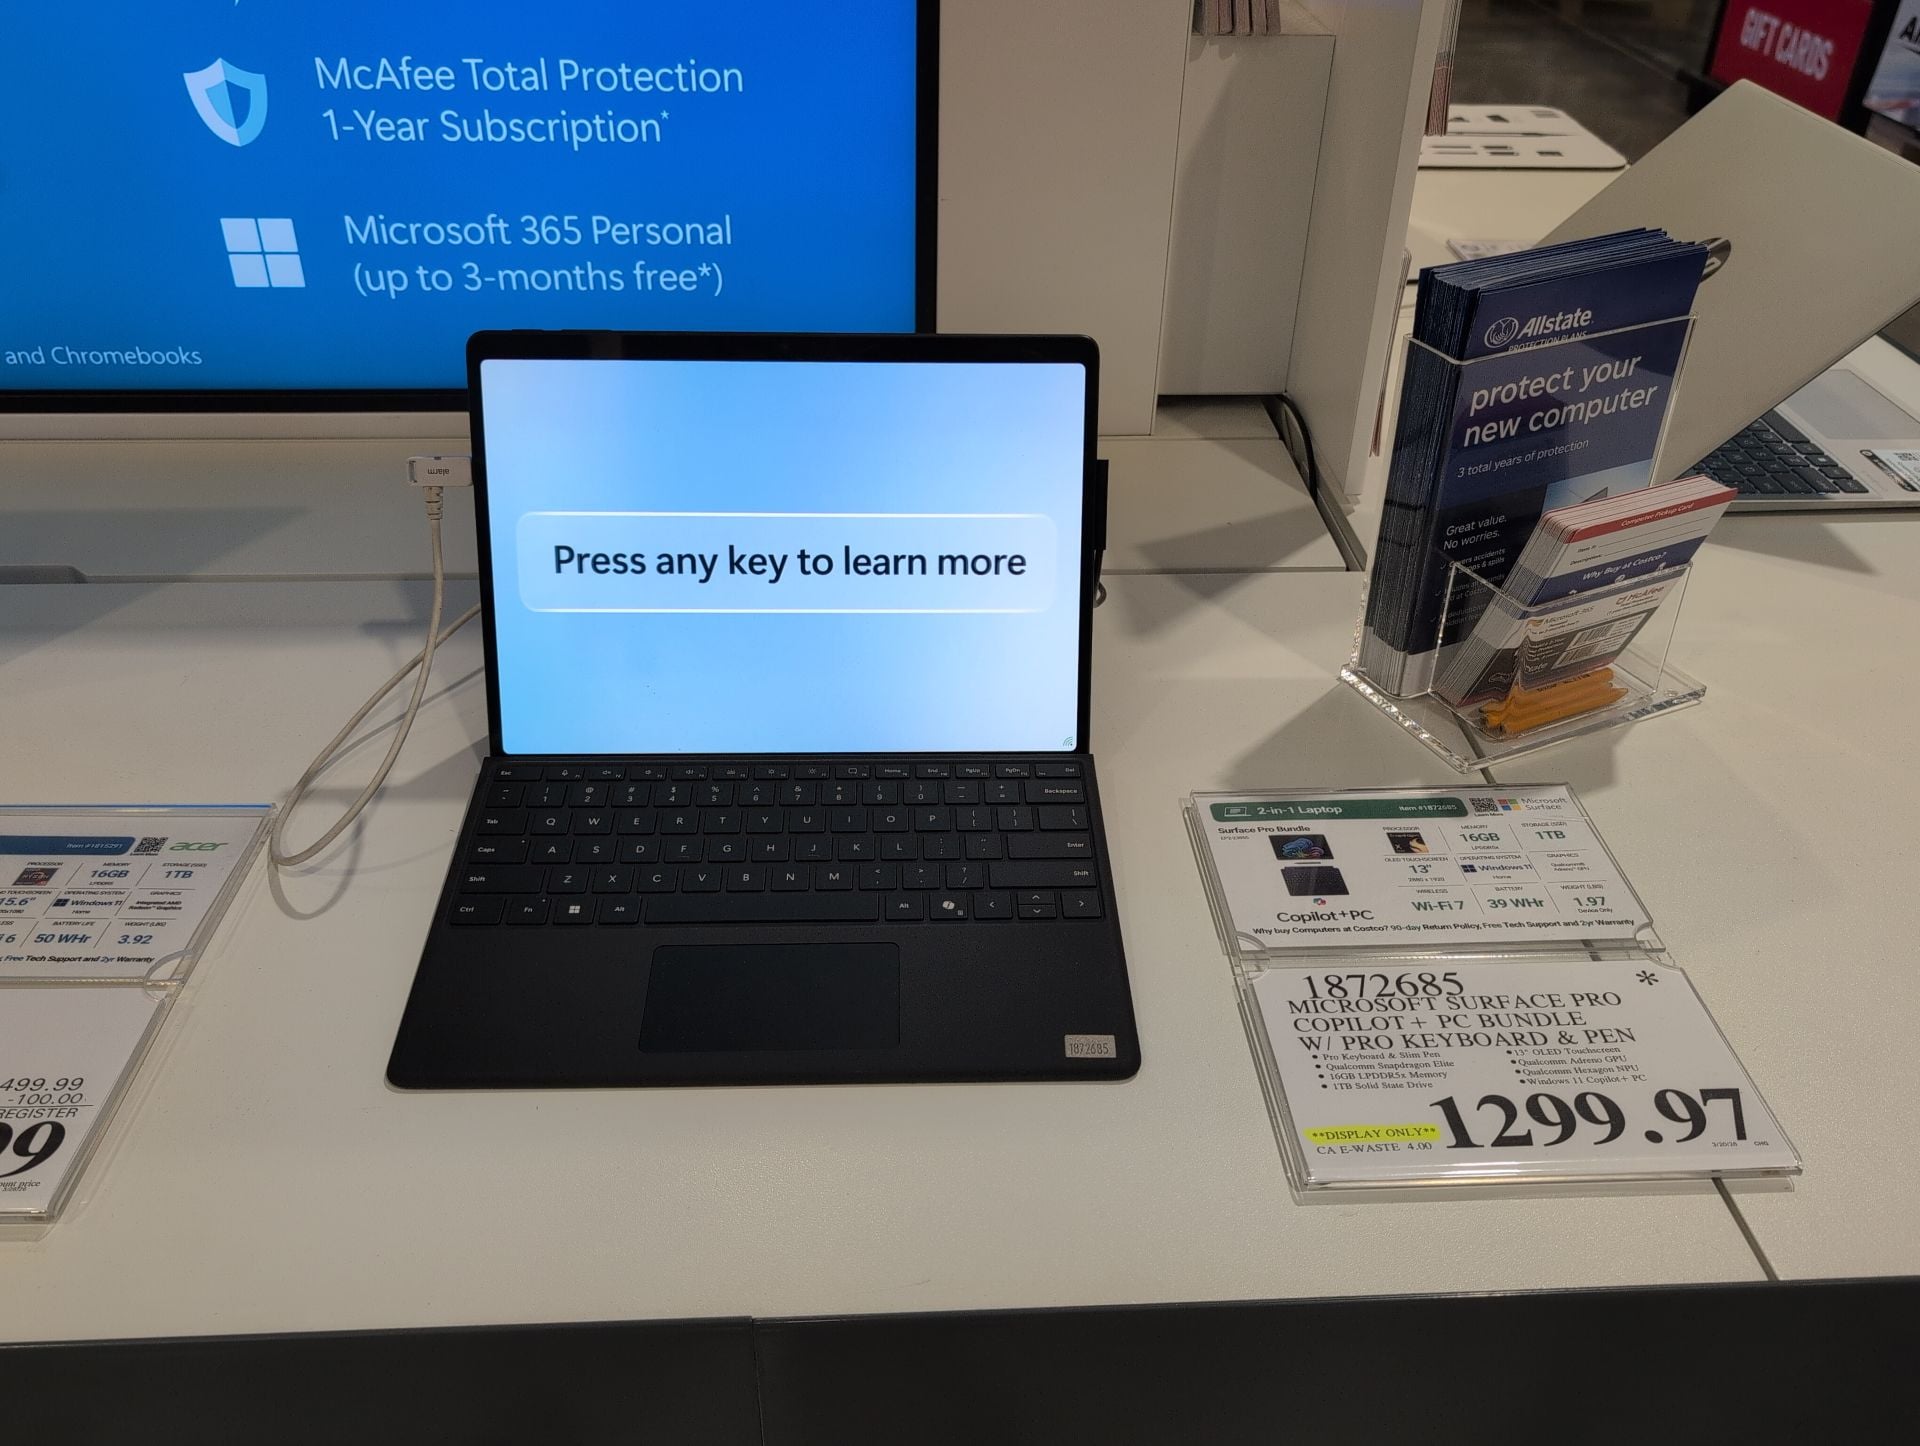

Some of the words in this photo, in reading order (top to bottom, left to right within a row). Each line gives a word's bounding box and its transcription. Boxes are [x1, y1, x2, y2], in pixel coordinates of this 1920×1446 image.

[1740, 7, 1781, 56] GIFT
[1775, 22, 1834, 81] CARDS
[314, 57, 455, 92] McAfee
[463, 59, 548, 92] Total
[559, 60, 744, 93] Protection
[323, 110, 429, 142] 1-Year
[344, 215, 511, 245] Microsoft
[521, 217, 582, 245] 365
[592, 216, 732, 245] Personal
[354, 263, 408, 300] (up
[416, 265, 452, 292] to
[463, 263, 624, 292] 3-months
[1517, 308, 1592, 340] Allstate
[1509, 336, 1559, 352] PROTECTION
[5, 345, 45, 365] and
[51, 344, 203, 366] Chromebooks
[1470, 367, 1574, 416] protect
[1580, 355, 1641, 392] your
[1463, 416, 1521, 448] new
[1529, 385, 1658, 432] computer
[1457, 467, 1464, 478] 3
[1468, 461, 1491, 476] total
[1493, 456, 1521, 471] years
[1525, 449, 1536, 462] of
[1536, 439, 1589, 460] protection
[428, 468, 450, 476] alarm
[1446, 521, 1475, 536] Great
[1479, 515, 1506, 528] value.
[1444, 540, 1458, 550] No
[1461, 530, 1500, 546] worries.
[553, 545, 646, 575] Press
[656, 552, 718, 584] any
[729, 545, 788, 584] key
[798, 548, 834, 575] to
[844, 545, 927, 576] learn
[937, 553, 1027, 576] more
[1583, 569, 1603, 580] Why
[1604, 565, 1621, 575] Buy
[1622, 562, 1632, 570] at
[1633, 552, 1666, 566] Costco?
[1257, 806, 1294, 815] 2-in-1
[1298, 806, 1342, 816] Laptop
[1459, 832, 1500, 842] 16GB
[1535, 830, 1566, 840] 1TB
[170, 842, 228, 850] acer
[478, 846, 495, 854] Caps
[91, 870, 130, 878] 16GB
[165, 870, 194, 878] 1TB
[1409, 864, 1432, 874] 13"
[1478, 864, 1523, 872] Windows
[1411, 901, 1453, 911] Wi-Fi
[1454, 900, 1464, 910] 7
[1487, 899, 1508, 908] 39
[1510, 898, 1544, 908] WHr
[1573, 896, 1606, 906] 1.97
[1292, 926, 1340, 934] Computers
[1390, 924, 1421, 932] 90-day
[1454, 922, 1482, 930] Policy,
[1527, 920, 1561, 930] Support
[1594, 919, 1634, 927] Warranty
[34, 934, 54, 943] 50
[58, 934, 92, 944] WHr
[118, 935, 153, 944] 3.92
[1302, 972, 1464, 999] 1872685
[1286, 998, 1438, 1014] MICROSOFT
[1446, 994, 1566, 1010] SURFACE
[1568, 992, 1622, 1006] PRO
[1293, 1016, 1406, 1032] COPILOT
[1411, 1016, 1428, 1029] +
[1436, 1014, 1472, 1028] PC
[1478, 1011, 1586, 1028] BUNDLE
[1298, 1036, 1332, 1052] W/
[1341, 1034, 1394, 1050] PRO
[1401, 1031, 1548, 1049] KEYBOARD
[1558, 1030, 1578, 1044] &
[1583, 1028, 1636, 1043] PEN
[1069, 1042, 1109, 1054] 1872685
[1532, 1048, 1562, 1056] OLED
[1565, 1046, 1620, 1054] Touchscreen
[1341, 1052, 1384, 1061] Keyboard
[1399, 1051, 1421, 1059] Slim
[1518, 1058, 1566, 1066] Qualcomm
[1568, 1056, 1602, 1064] Adreno
[1605, 1055, 1627, 1063] GPU
[1326, 1062, 1374, 1071] Qualcomm
[1378, 1061, 1431, 1071] Snapdragon
[1432, 1060, 1454, 1068] Elite
[1522, 1068, 1572, 1076] Qualcomm
[1574, 1066, 1614, 1075] Hexagon
[1616, 1064, 1639, 1072] NPU
[1330, 1072, 1355, 1080] 16GB
[1358, 1072, 1406, 1080] LPDDR5x
[1408, 1071, 1448, 1080] Memory
[1526, 1076, 1570, 1085] Windows
[1572, 1076, 1584, 1084] 11
[1586, 1076, 1628, 1085] Copilot+
[1631, 1074, 1648, 1082] PC
[0, 1078, 84, 1092] 499.99
[1333, 1082, 1352, 1090] 1TB
[1356, 1081, 1380, 1090] Solid
[1382, 1081, 1404, 1089] State
[8, 1093, 84, 1104] -100.00
[1429, 1088, 1747, 1149] 1299.97
[1317, 1145, 1337, 1155] CA
[1340, 1143, 1400, 1154] E-WASTE
[1407, 1142, 1432, 1150] 4.00
[18, 1180, 40, 1188] price
